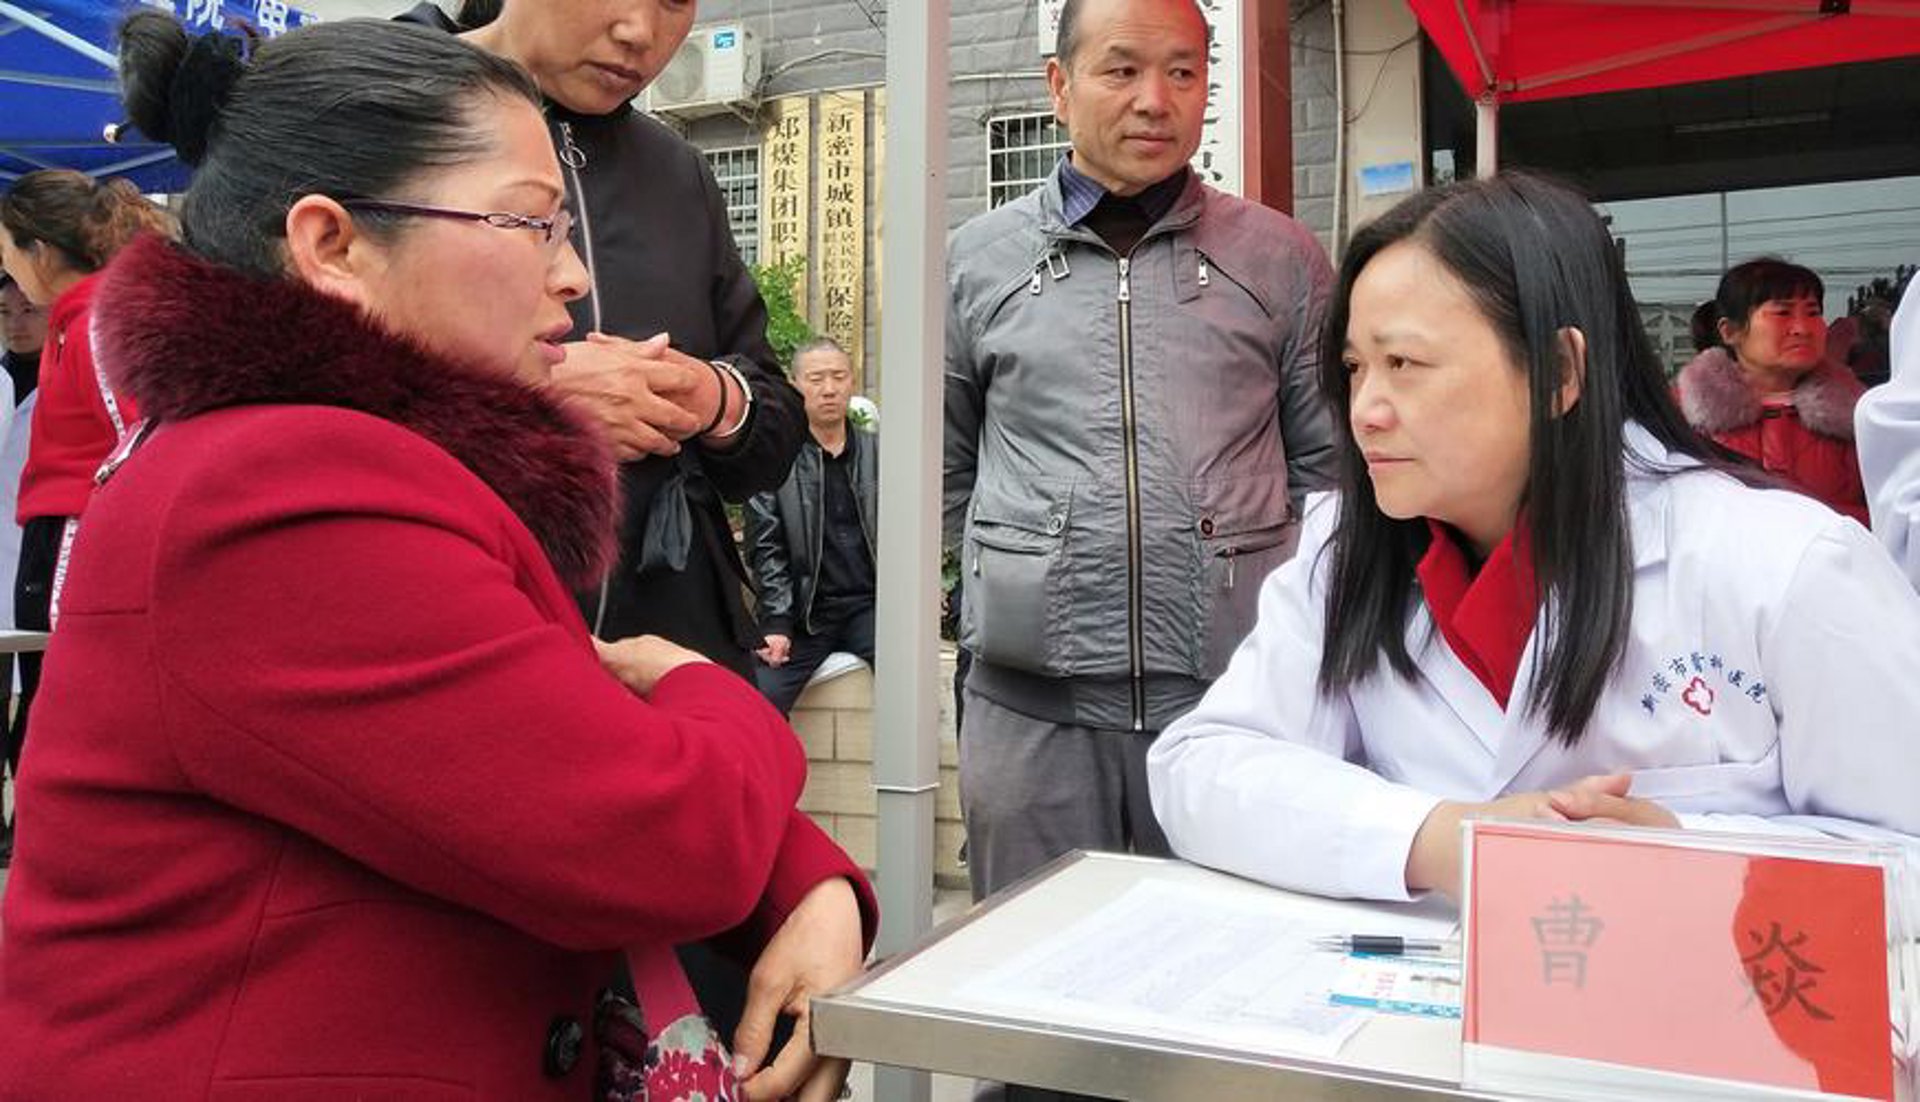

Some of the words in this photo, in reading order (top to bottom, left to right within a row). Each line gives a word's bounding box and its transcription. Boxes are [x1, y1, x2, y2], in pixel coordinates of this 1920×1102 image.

[824, 111, 855, 228] 新密市城镇
[1530, 893, 1604, 989] 曹
[1737, 920, 1836, 1022] 焱
